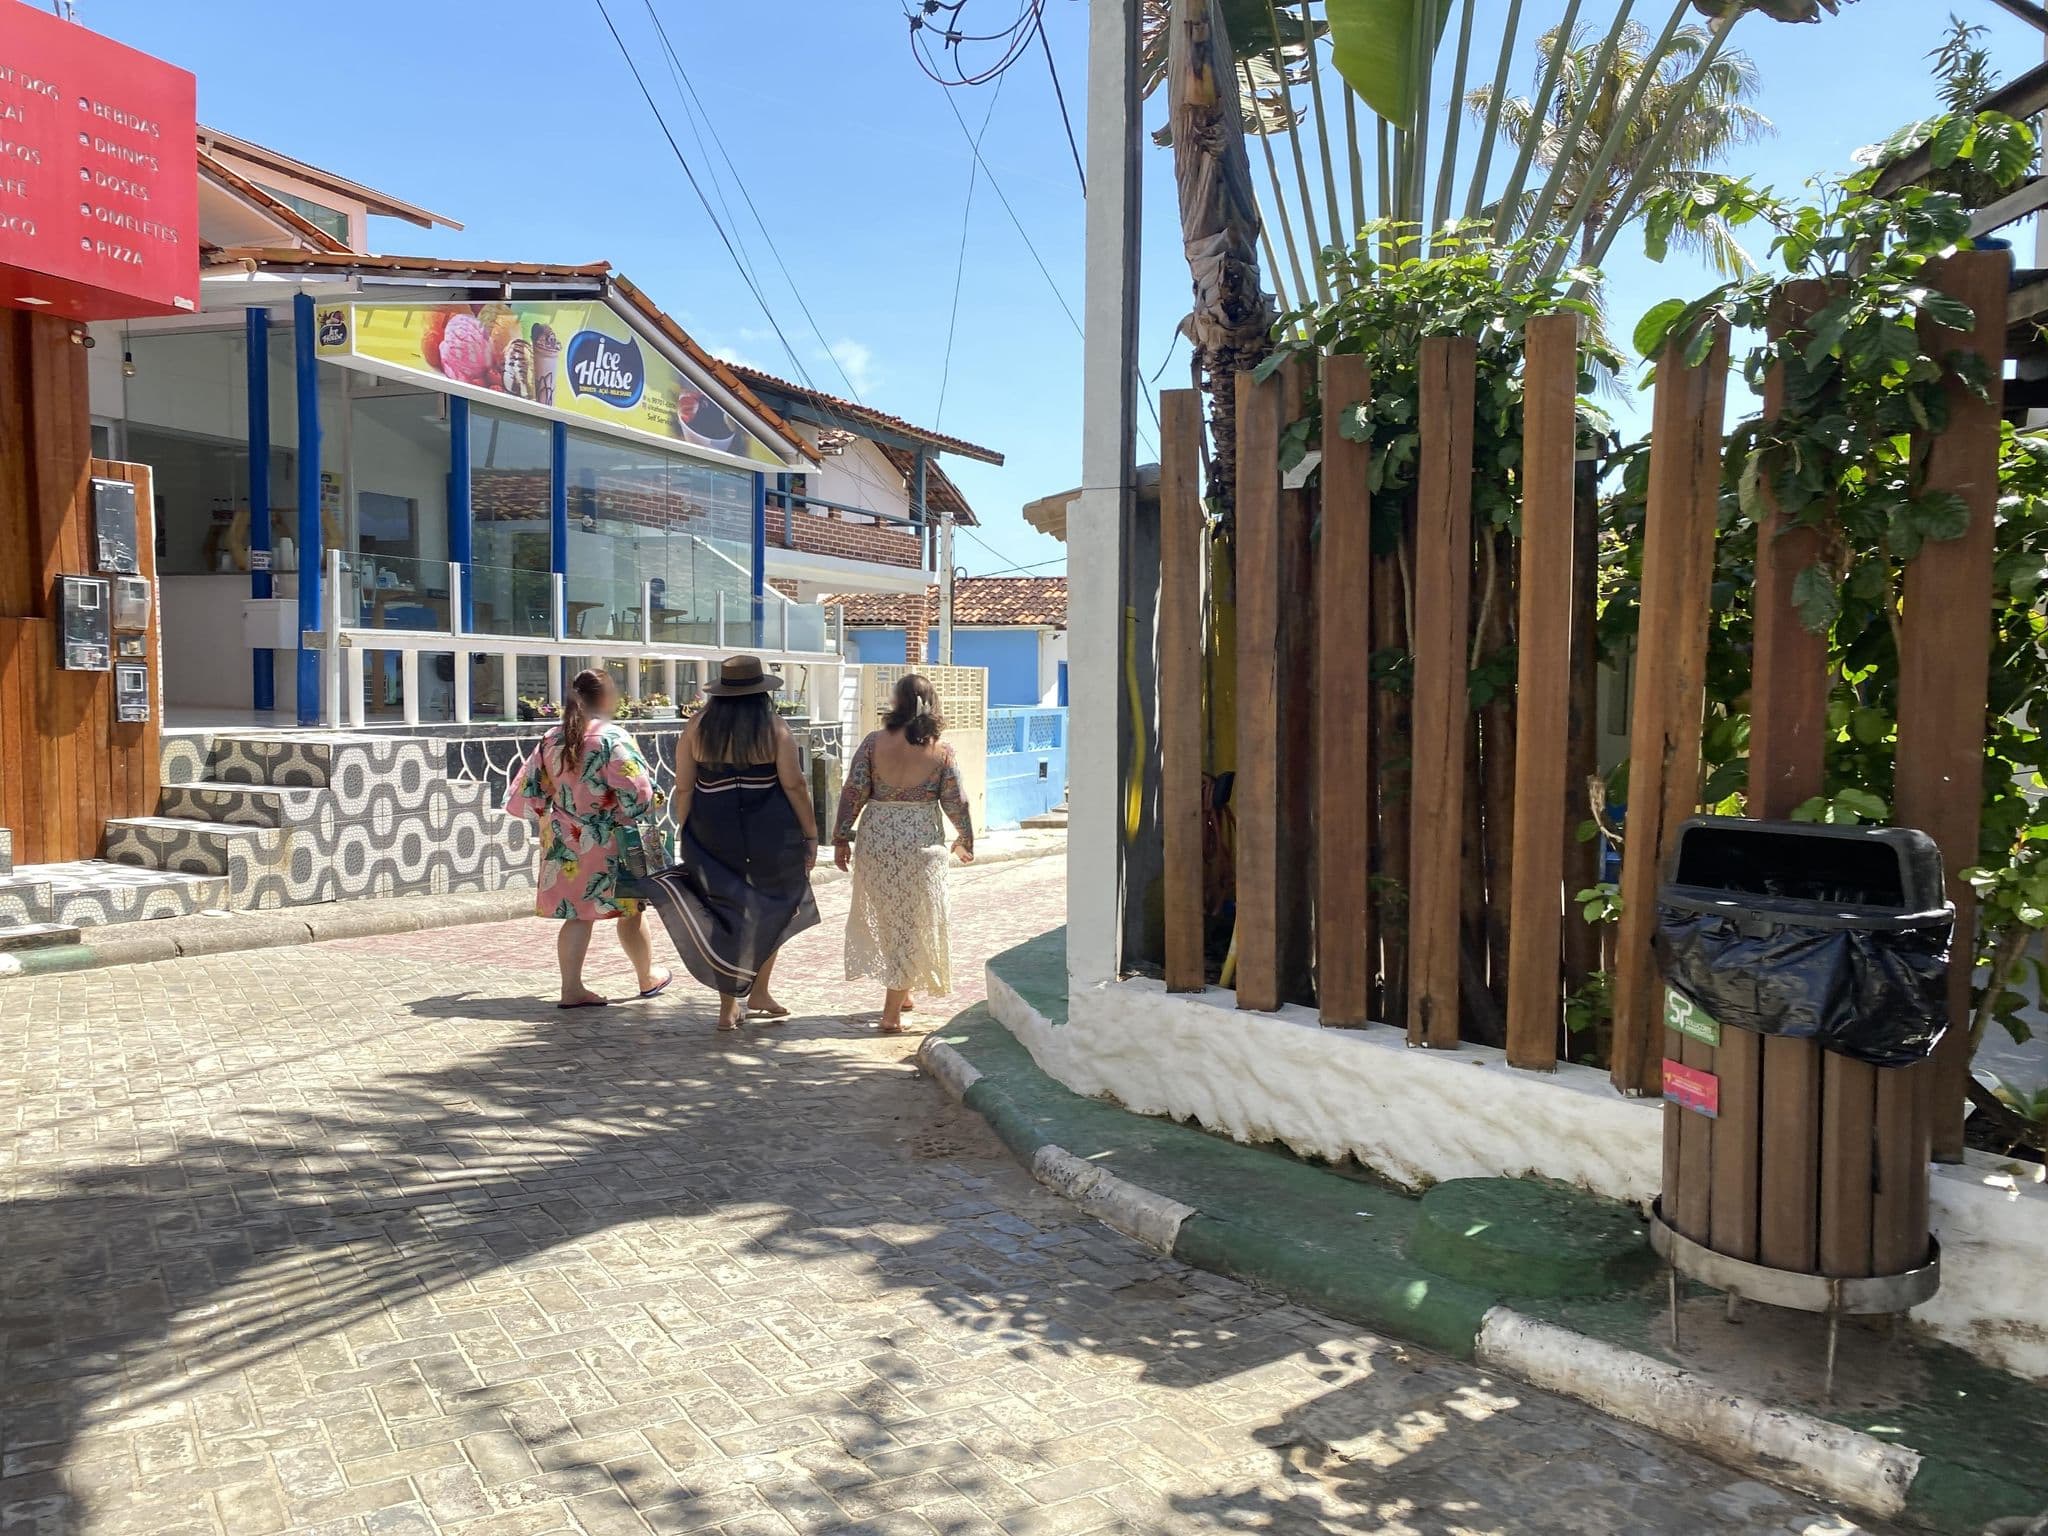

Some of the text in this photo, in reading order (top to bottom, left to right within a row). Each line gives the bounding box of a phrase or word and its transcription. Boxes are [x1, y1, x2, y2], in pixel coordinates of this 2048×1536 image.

[21, 74, 60, 101] DOG
[0, 101, 24, 123] AÍ
[93, 101, 159, 137] BEBIDAS
[0, 139, 41, 165] COS
[95, 137, 159, 171] DRINK'S
[95, 171, 149, 201] DOSES
[95, 207, 178, 243] OMELETES
[97, 240, 144, 265] PIZZA
[574, 360, 633, 390] House
[647, 412, 658, 421] Self
